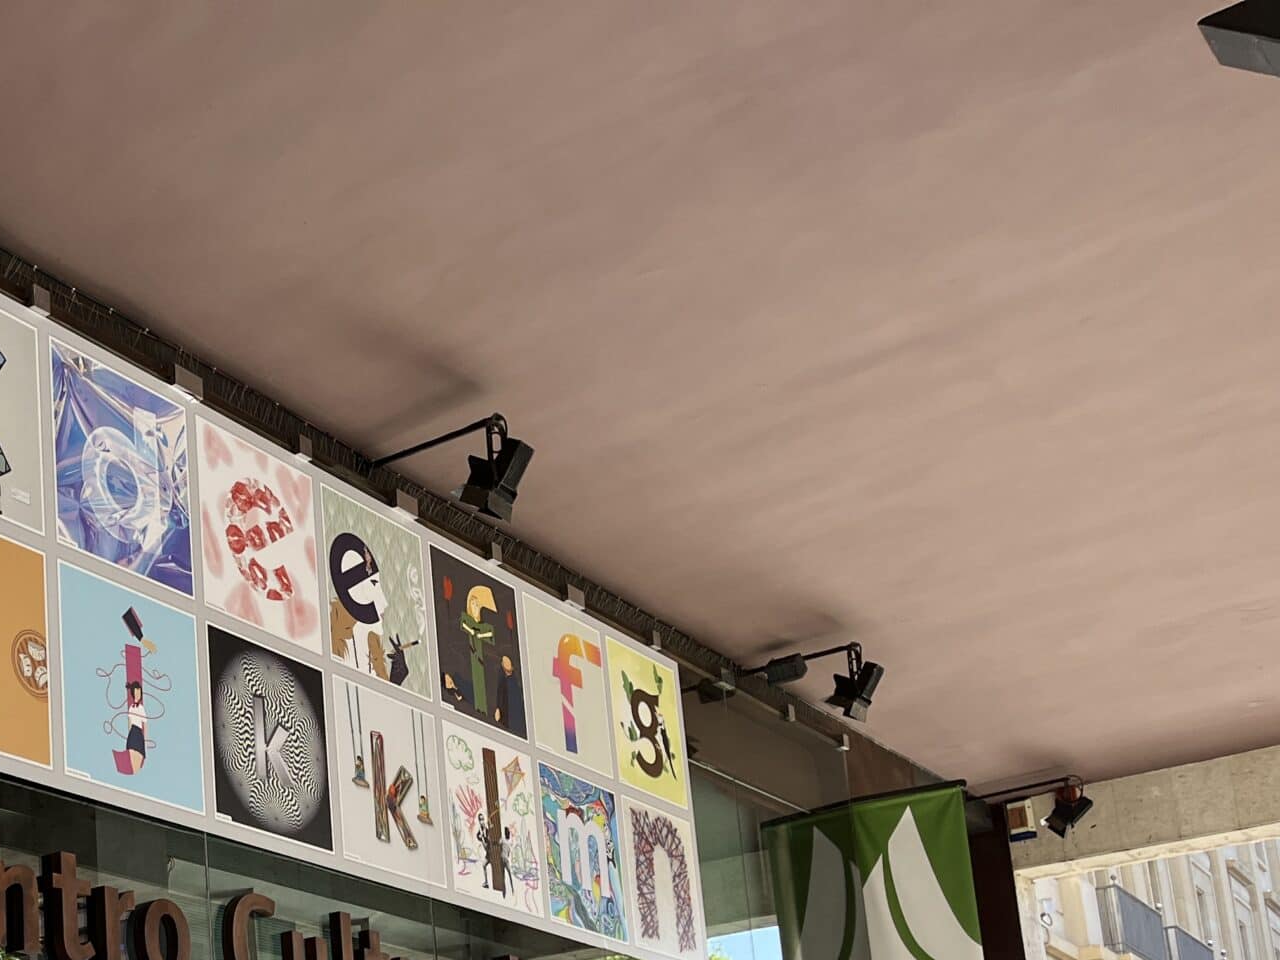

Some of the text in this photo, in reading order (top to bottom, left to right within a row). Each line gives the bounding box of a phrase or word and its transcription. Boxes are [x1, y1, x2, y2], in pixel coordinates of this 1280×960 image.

[329, 532, 380, 625] e
[551, 632, 602, 755] f
[630, 688, 665, 779] g
[370, 730, 419, 851] k
[630, 806, 697, 954] n
